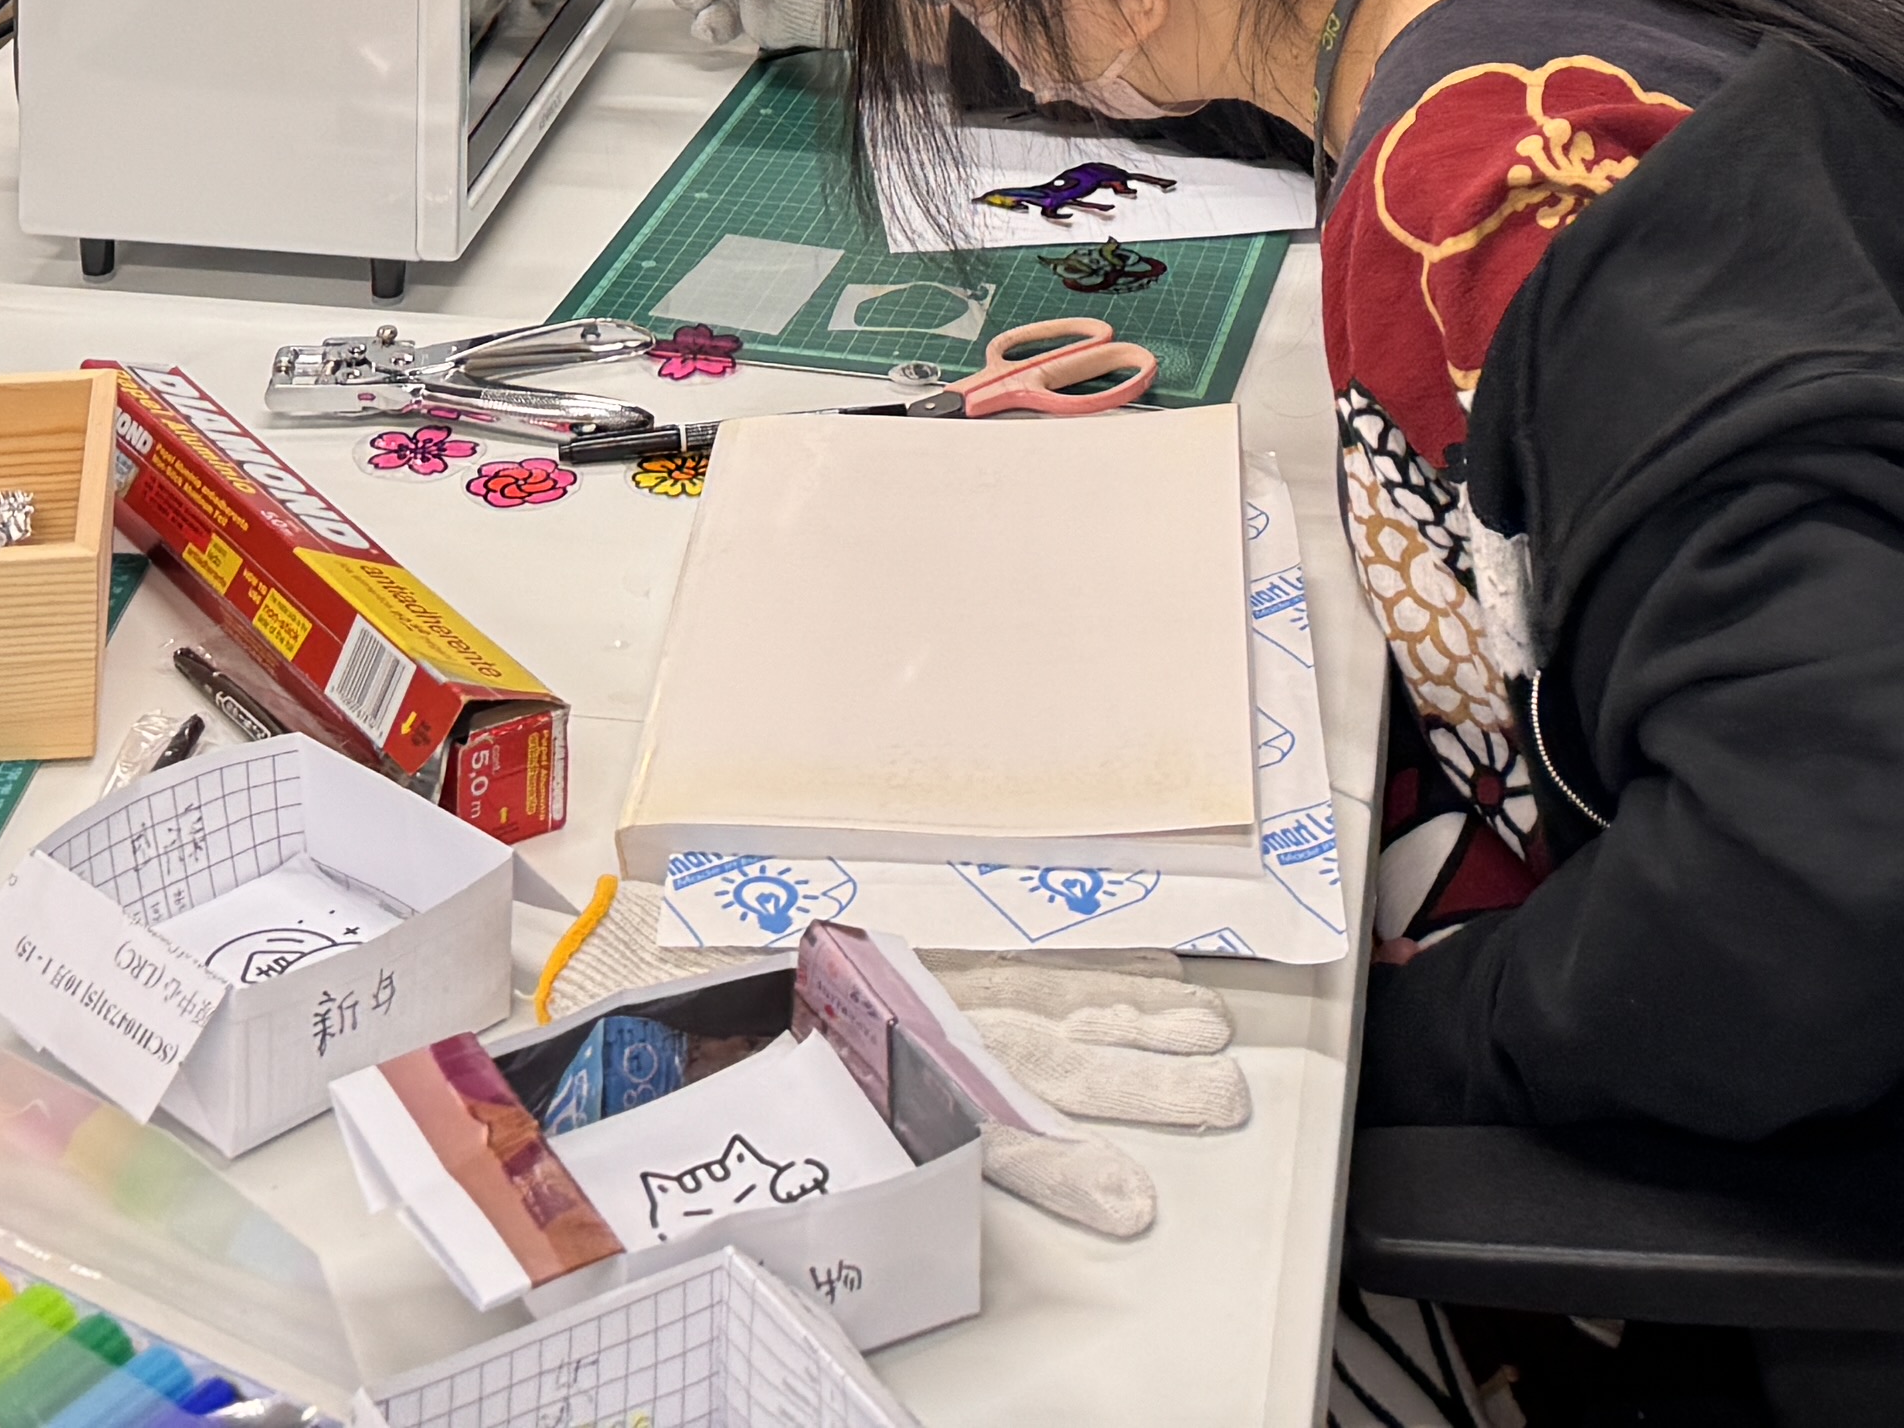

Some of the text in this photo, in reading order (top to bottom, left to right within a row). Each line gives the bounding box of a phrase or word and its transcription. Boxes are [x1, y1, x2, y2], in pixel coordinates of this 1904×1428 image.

[126, 364, 372, 550] DIAMOND
[161, 419, 256, 495] Aluminio
[359, 564, 502, 679] antiadherente
[113, 939, 167, 989] (LRC)
